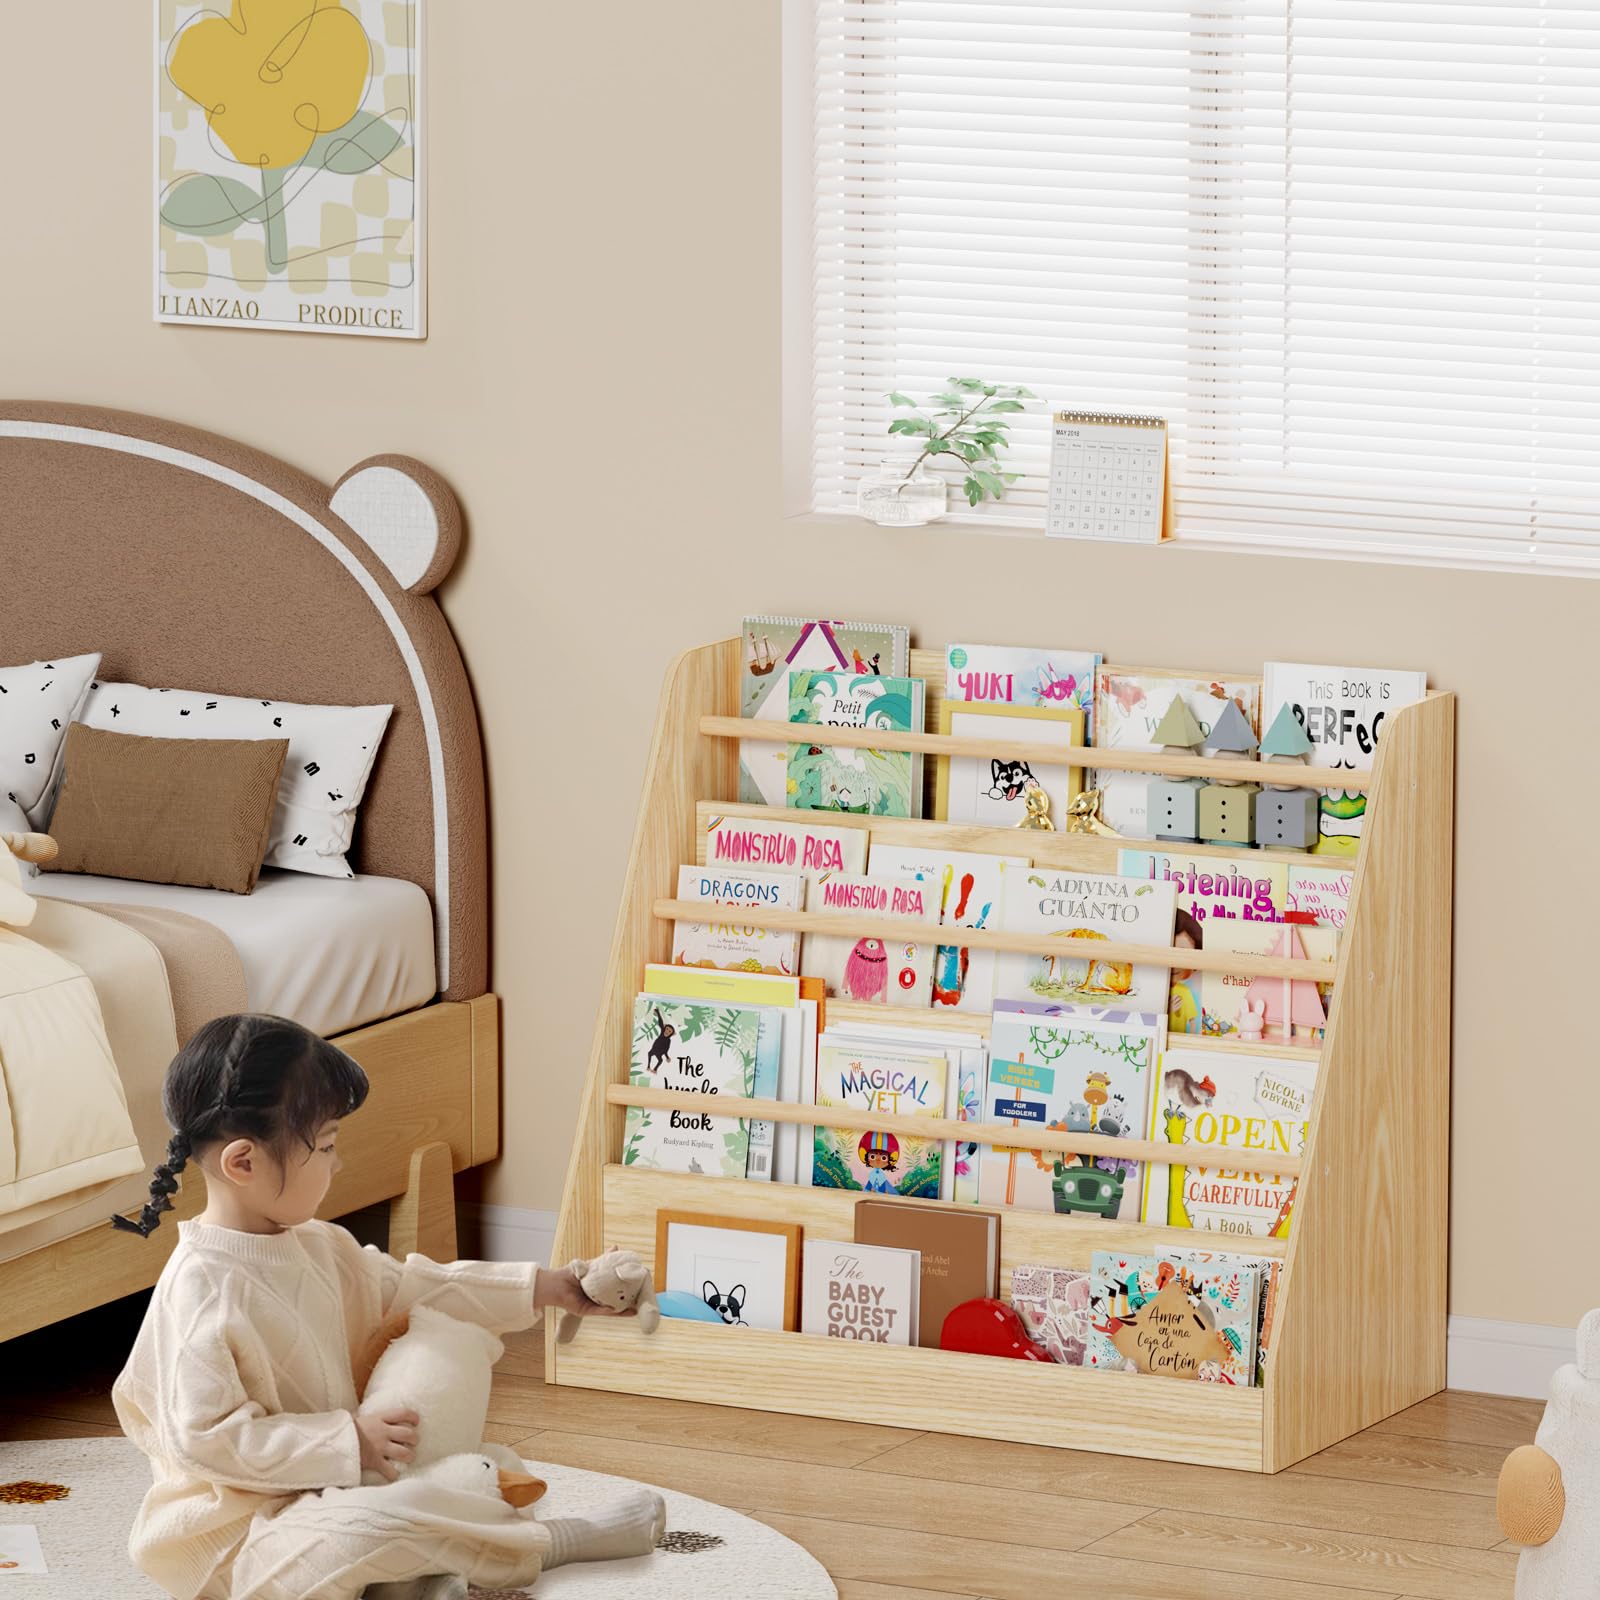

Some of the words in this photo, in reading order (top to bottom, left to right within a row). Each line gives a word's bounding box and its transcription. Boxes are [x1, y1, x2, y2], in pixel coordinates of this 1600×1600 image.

[298, 303, 402, 329] PRODUCE
[958, 671, 1014, 702] YUKI
[832, 699, 862, 715] Petit
[714, 830, 797, 866] MONSTRUO
[801, 834, 844, 872] ROSA
[700, 878, 780, 903] DRAGONS
[823, 882, 888, 911] MONSTRUO
[891, 886, 924, 916] ROSA
[1049, 878, 1129, 898] ADIVINA
[677, 1055, 704, 1078] The
[849, 1061, 863, 1073] THE
[841, 1069, 929, 1105] MAGICAL
[1263, 1077, 1305, 1104] NICOLA
[863, 1090, 902, 1115] YET
[1002, 1108, 1038, 1118] TODDLERS
[1261, 1089, 1302, 1113] O'BYRNE
[669, 1110, 714, 1132] Book
[1194, 1111, 1297, 1153] OPEN
[663, 1137, 690, 1148] Rudyard
[691, 1140, 714, 1150] Kipling
[1189, 1182, 1284, 1211] CAREFULLY
[1203, 1217, 1212, 1231] A
[829, 1254, 865, 1280] The
[828, 1280, 885, 1306] BABY
[827, 1302, 898, 1328] GUEST
[1148, 1305, 1185, 1327] Amor
[828, 1323, 890, 1344] BOOK
[1136, 1330, 1159, 1353] Caja
[1161, 1335, 1174, 1350] de
[1158, 1325, 1169, 1337] en
[1172, 1328, 1191, 1338] una
[1149, 1349, 1199, 1374] Cartón
